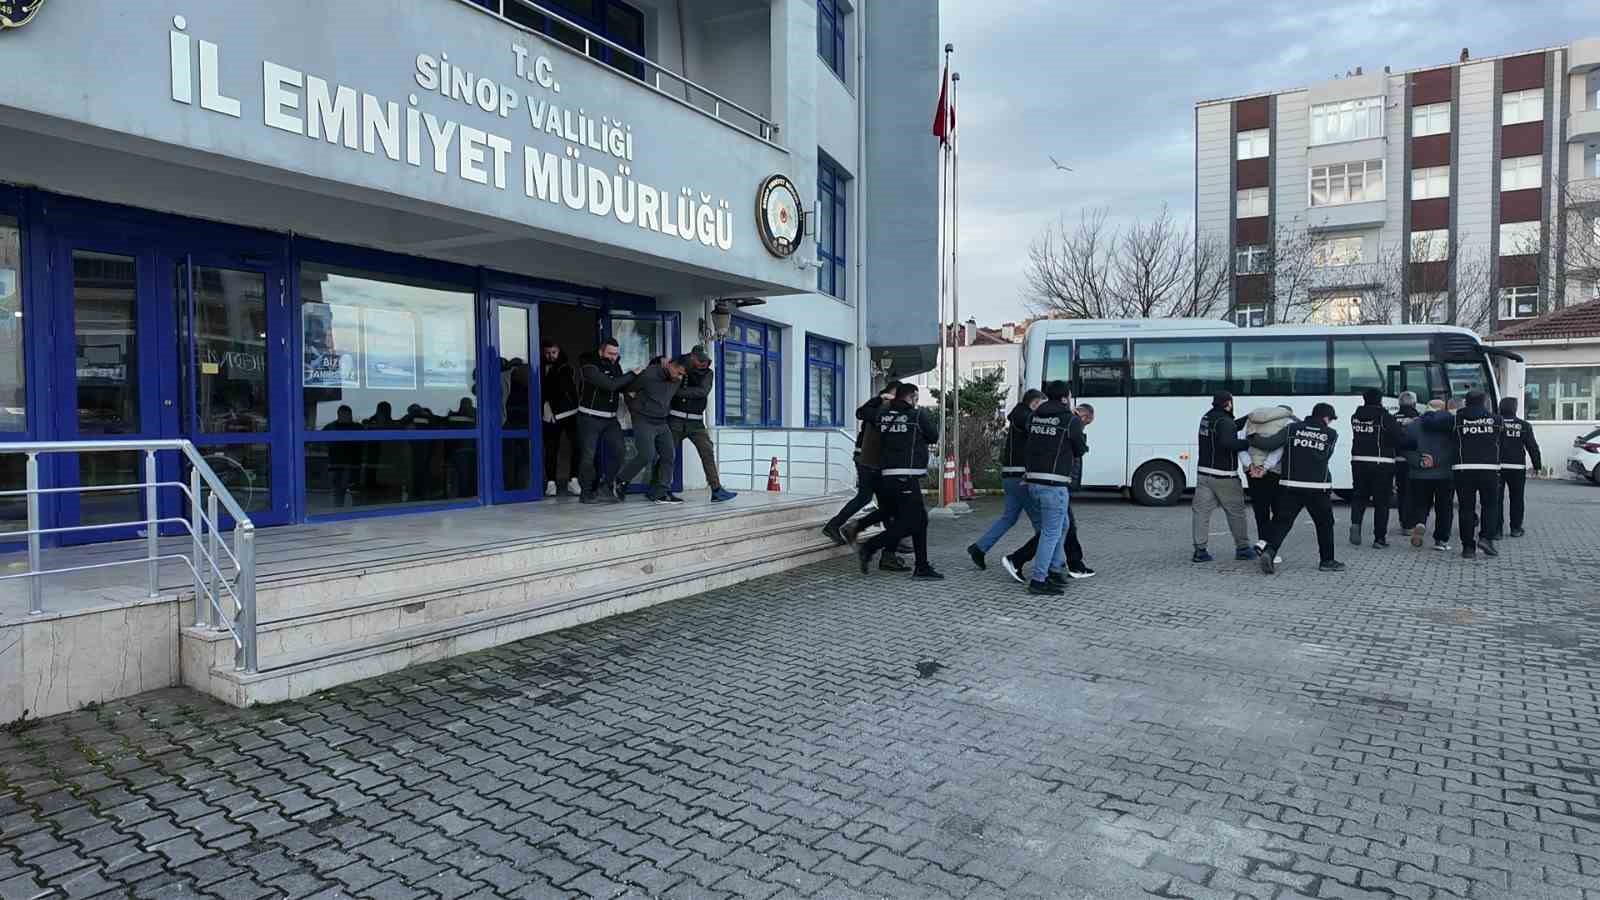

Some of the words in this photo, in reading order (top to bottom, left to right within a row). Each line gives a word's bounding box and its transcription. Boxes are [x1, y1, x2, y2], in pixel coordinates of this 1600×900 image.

[415, 52, 518, 118] SİNOP
[526, 95, 633, 161] VALİLİĞİ
[512, 43, 560, 93] T.C.
[170, 15, 241, 118] İL
[263, 60, 512, 190] EMNİYET
[524, 144, 733, 250] MÜDÜRLÜĞÜ
